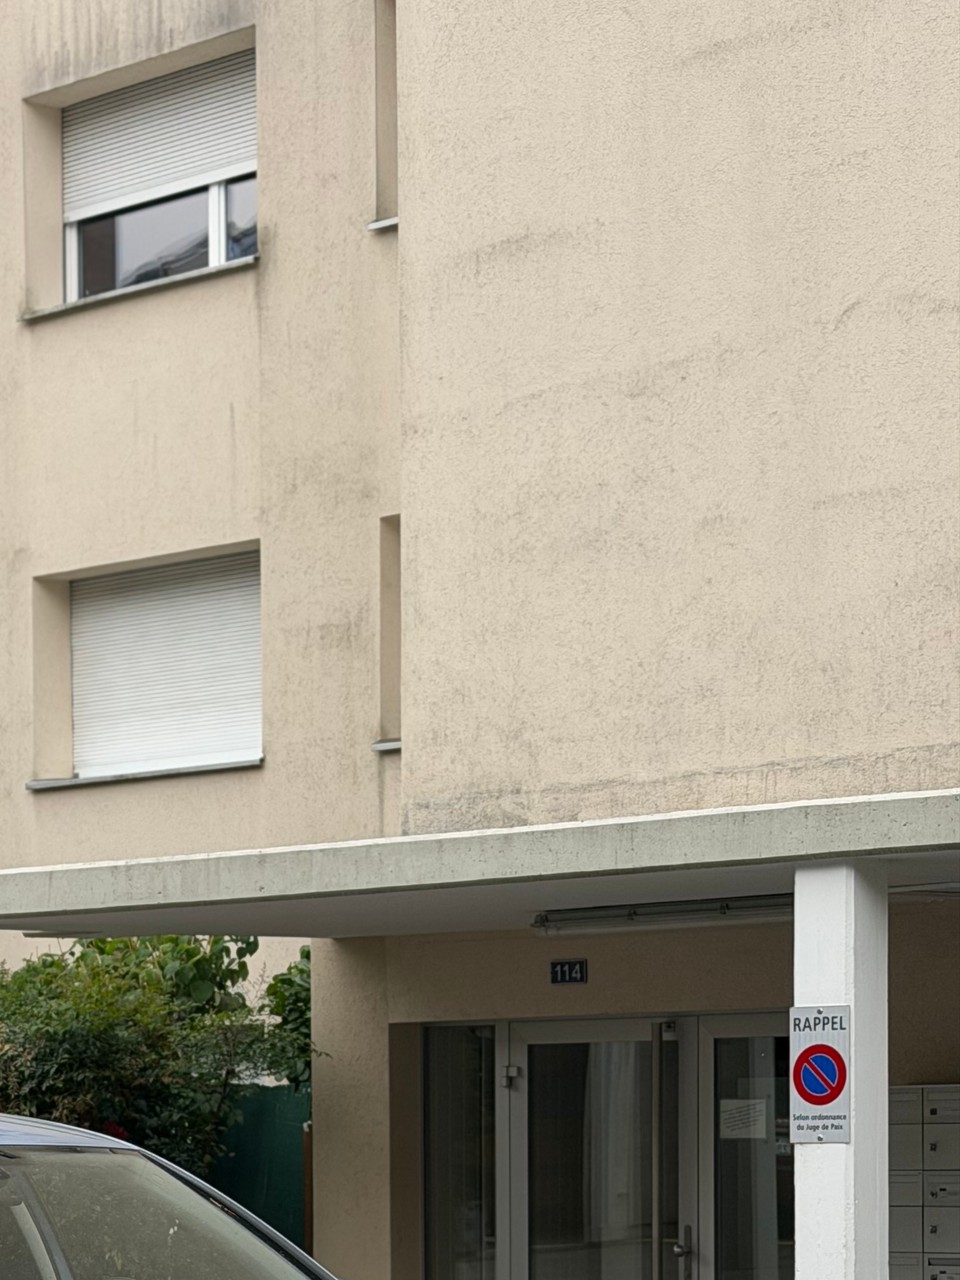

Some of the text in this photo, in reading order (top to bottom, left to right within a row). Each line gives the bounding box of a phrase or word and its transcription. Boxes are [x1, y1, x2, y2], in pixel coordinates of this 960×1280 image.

[554, 963, 582, 981] 114
[793, 1015, 847, 1032] RAPPEL
[793, 1113, 847, 1121] Selon ordonnance
[796, 1123, 805, 1131] du
[806, 1124, 820, 1132] Juge
[821, 1123, 829, 1131] de
